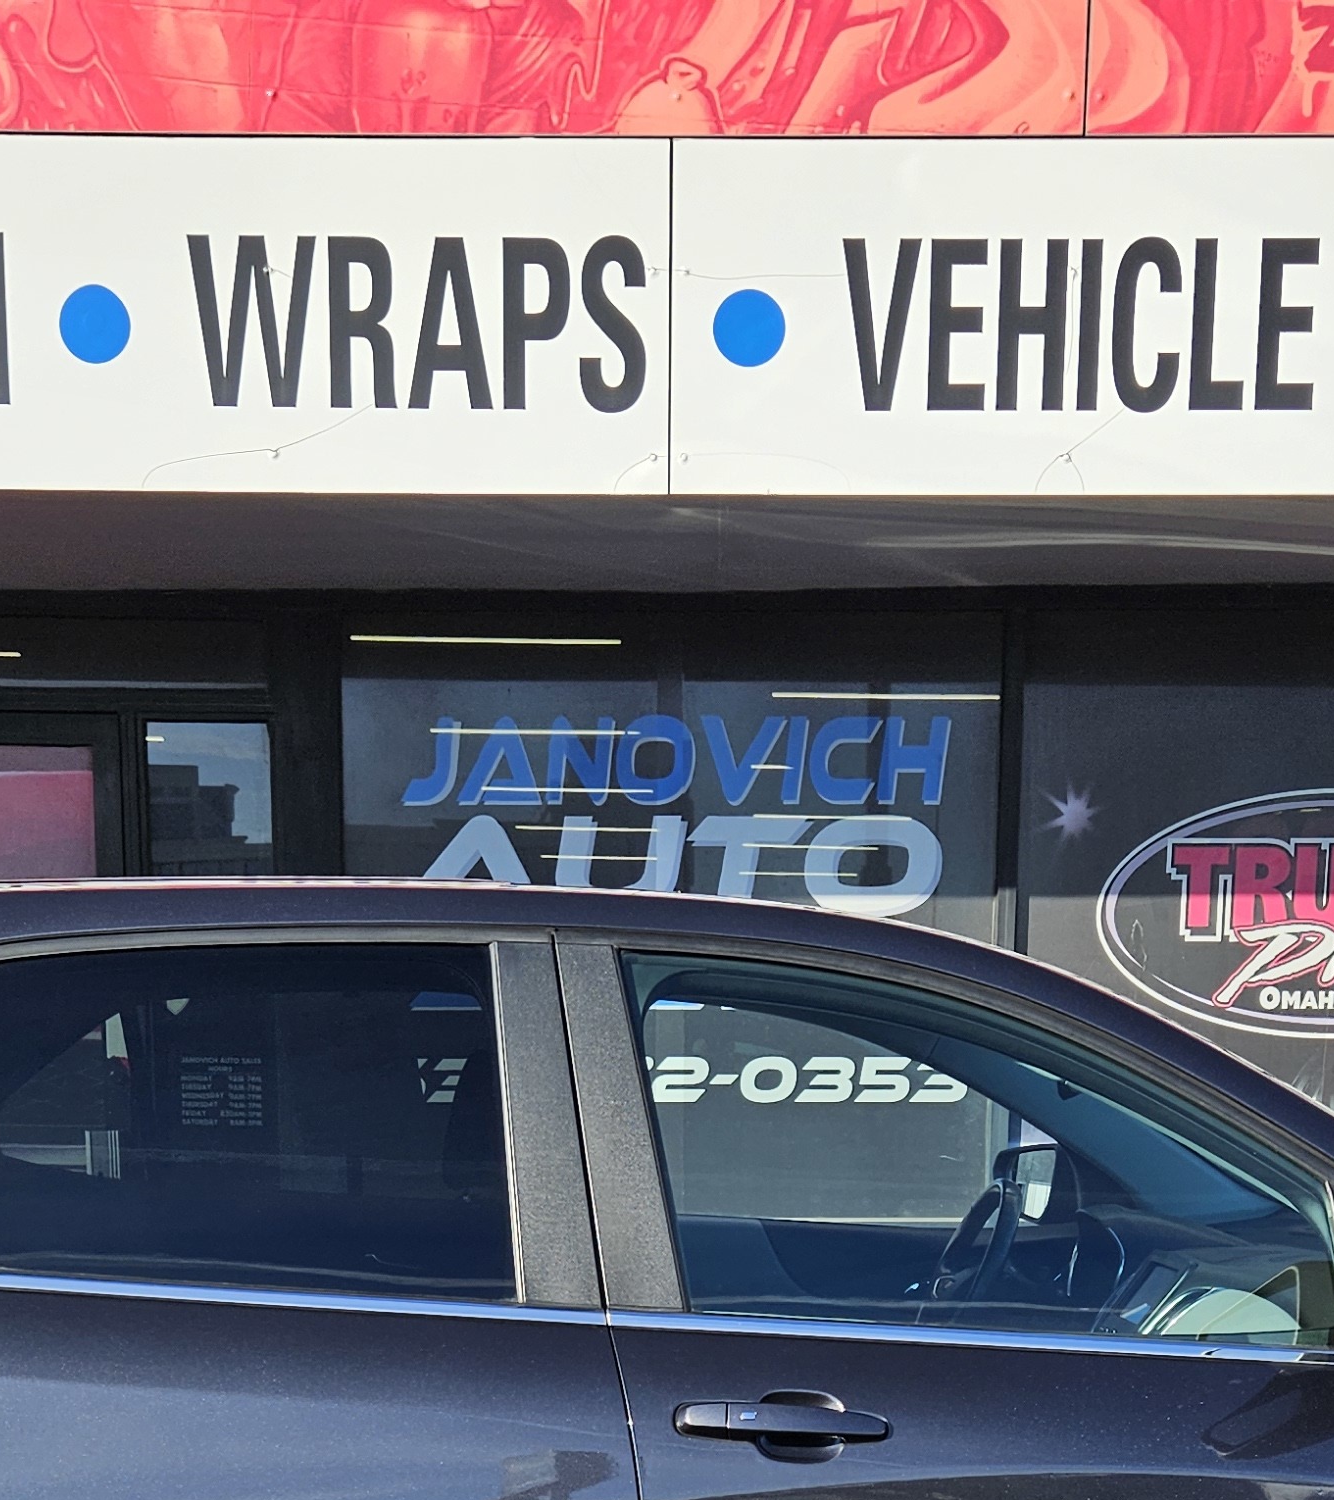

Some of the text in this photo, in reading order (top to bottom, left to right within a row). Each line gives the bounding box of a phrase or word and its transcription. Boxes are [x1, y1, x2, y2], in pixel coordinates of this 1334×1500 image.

[186, 234, 646, 414] WRAPS
[842, 236, 1321, 414] VEHICLE
[401, 713, 952, 808] JANOVICH
[423, 813, 943, 918] AUTO
[219, 1057, 240, 1065] AUTO
[644, 1055, 968, 1105] 2-0353
